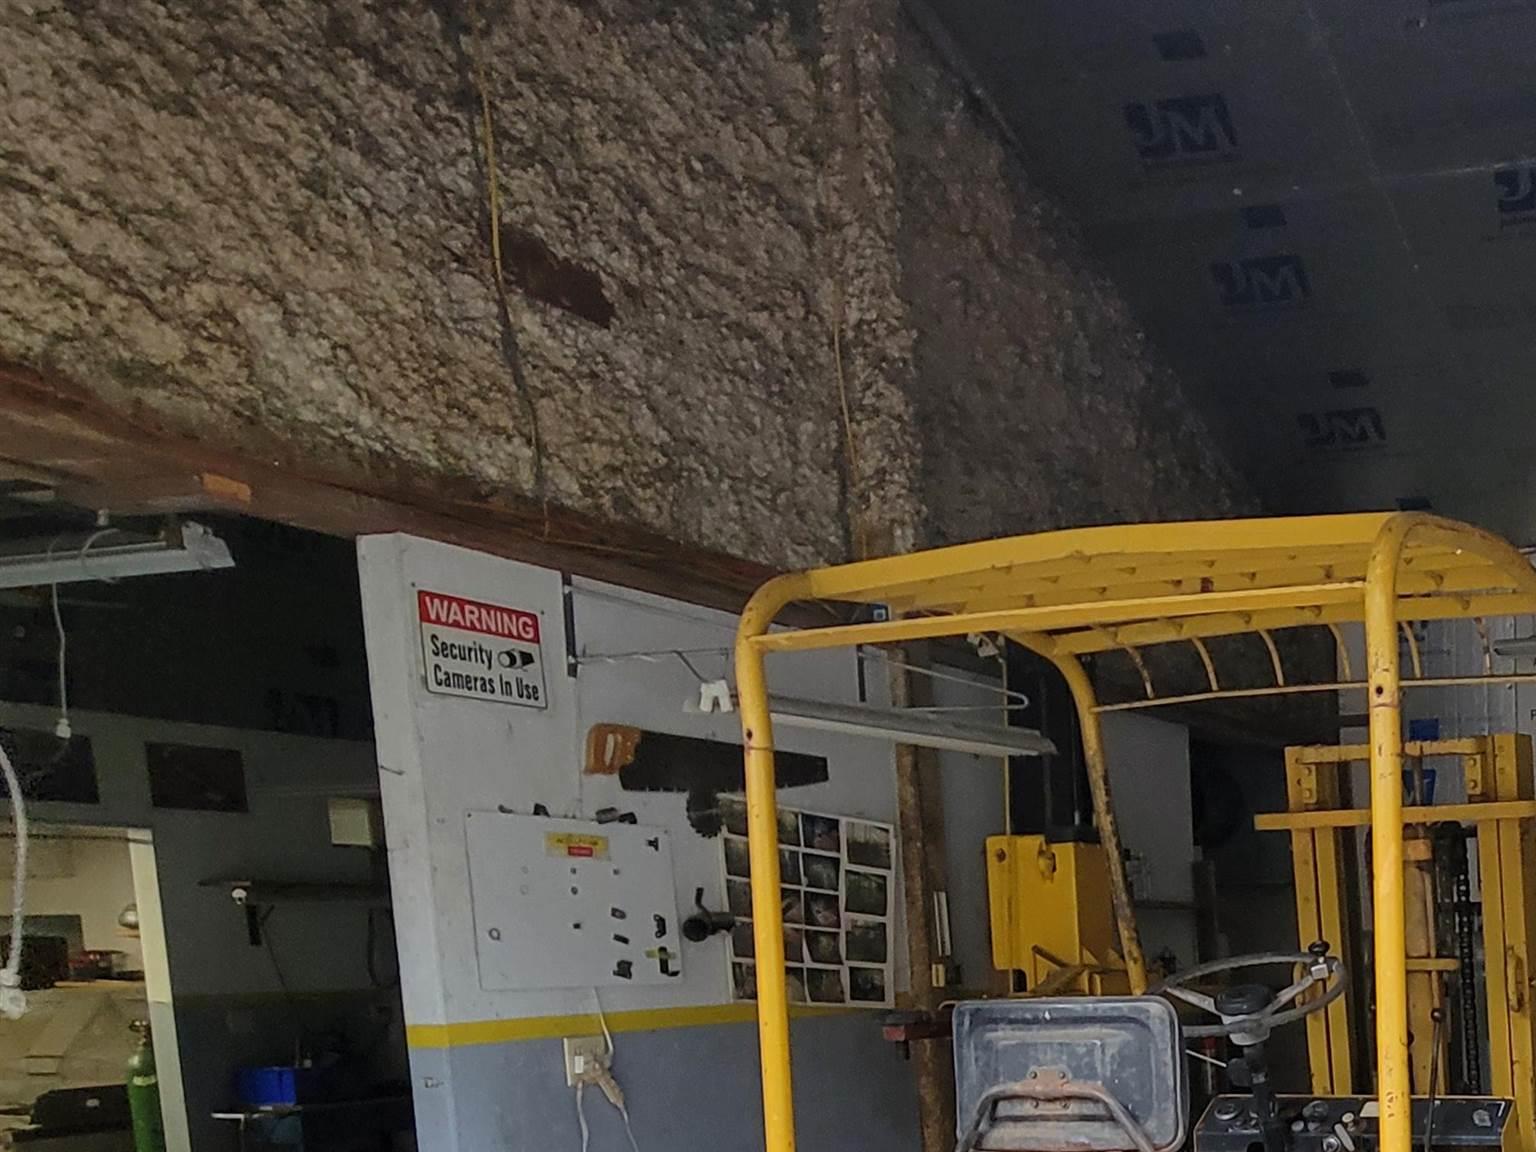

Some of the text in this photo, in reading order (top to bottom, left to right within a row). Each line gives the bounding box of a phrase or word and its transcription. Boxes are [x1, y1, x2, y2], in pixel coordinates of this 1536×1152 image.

[425, 596, 534, 639] WARNING
[430, 634, 493, 671] Security
[434, 664, 539, 701] Cameras In Use
